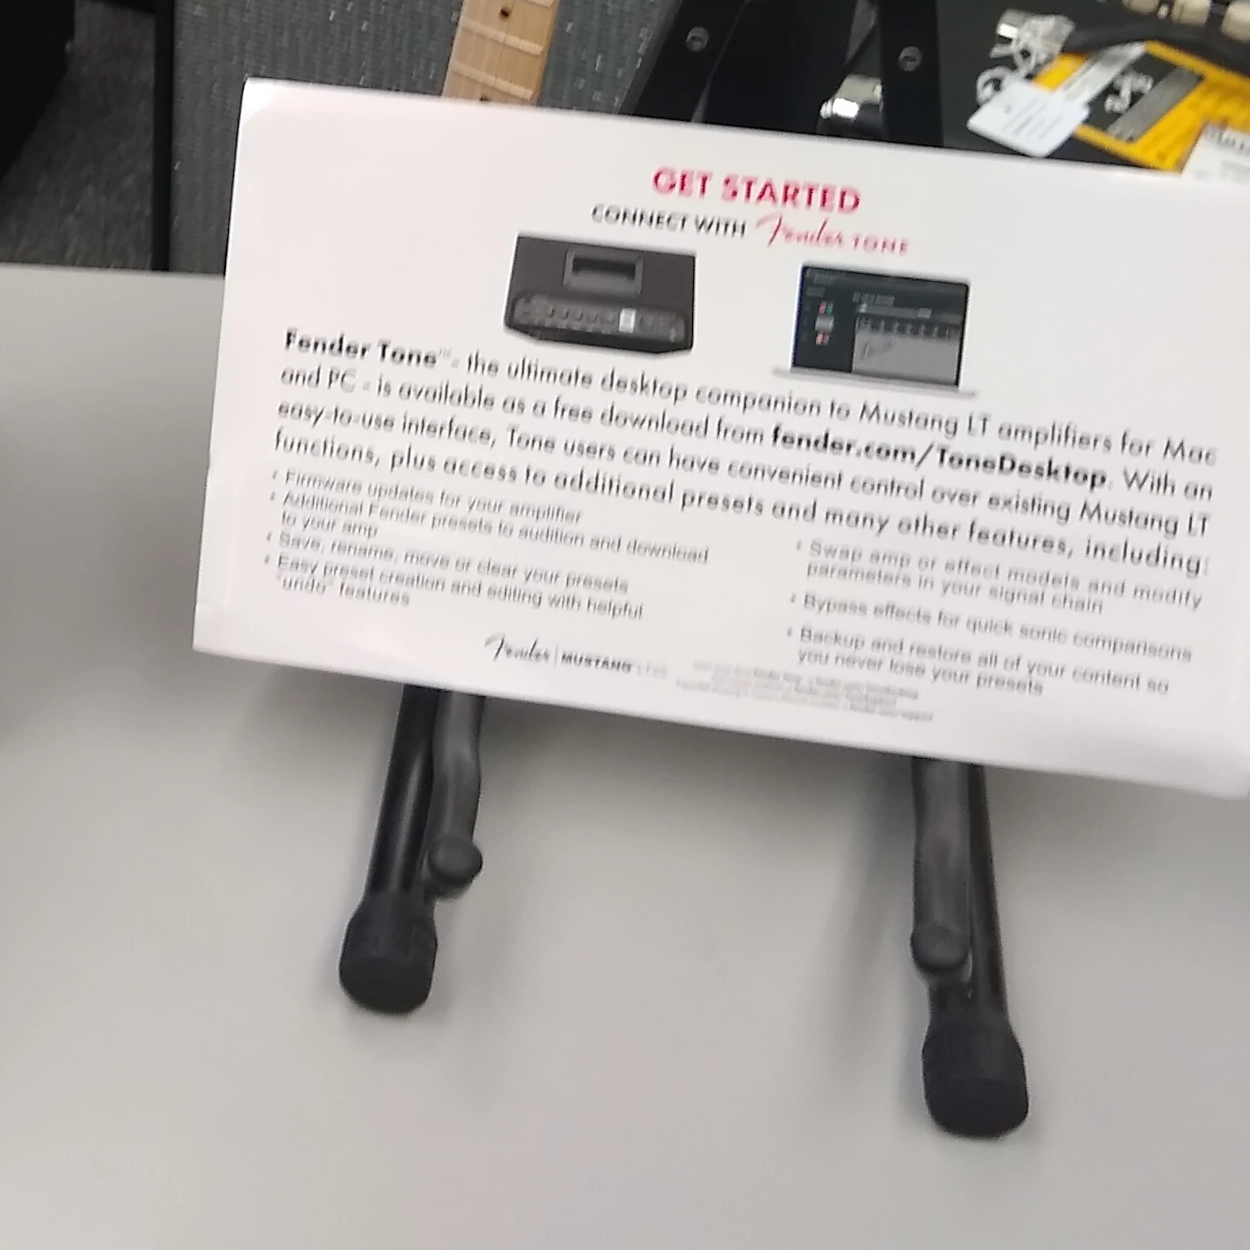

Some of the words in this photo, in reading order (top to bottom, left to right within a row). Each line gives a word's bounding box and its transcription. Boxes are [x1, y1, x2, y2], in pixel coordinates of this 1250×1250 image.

[650, 164, 714, 200] GET
[720, 170, 863, 216] STARTED
[591, 203, 688, 232] CONNECT
[693, 215, 747, 239] WITH
[753, 209, 845, 255] Fender
[851, 233, 910, 257] TONE
[279, 360, 323, 388] and
[326, 367, 358, 393] PC
[375, 374, 395, 399] is
[397, 375, 498, 411] available
[500, 396, 528, 415] as
[530, 400, 549, 418] a
[552, 395, 596, 424] free
[597, 401, 711, 439] download
[710, 415, 767, 446] from
[1118, 466, 1179, 496] With
[1182, 482, 1214, 501] an
[283, 327, 373, 360] Fender
[465, 350, 502, 377] the
[506, 355, 595, 389] ultimate
[598, 366, 690, 406] desktop
[693, 384, 823, 423] companion
[827, 399, 852, 421] to
[857, 400, 961, 440] Mustang
[965, 412, 992, 438] LT
[995, 414, 1115, 459] amplifiers
[1119, 430, 1156, 458] for
[1162, 437, 1217, 465] Mac
[273, 427, 382, 468] functions,
[389, 443, 438, 478] plus
[442, 458, 518, 482] access
[523, 464, 548, 487] to
[553, 464, 676, 504] additional
[680, 487, 765, 521] presets
[770, 495, 818, 523] and
[823, 507, 890, 537] many
[897, 510, 961, 541] other
[967, 520, 1075, 558] features,
[275, 399, 397, 438] easy-to-use
[399, 410, 500, 449] interface,
[503, 426, 559, 453] Tone
[561, 439, 618, 462] users
[621, 447, 662, 467] can
[666, 445, 723, 476] have
[726, 457, 845, 492] convenient
[849, 468, 926, 501] control
[929, 486, 982, 509] over
[985, 490, 1073, 525] existing
[1076, 499, 1185, 541] Mustang
[1185, 512, 1213, 537] LT
[284, 469, 364, 496] Firmware
[366, 479, 436, 509] updates
[439, 489, 464, 509] for
[465, 495, 505, 518] your
[507, 500, 582, 528] amplifier
[277, 529, 328, 554] Save,
[329, 538, 401, 565] rename,
[402, 548, 451, 571] move
[453, 556, 473, 574] or
[475, 558, 520, 579] clear
[521, 566, 562, 589] your
[564, 571, 631, 597] presets
[282, 491, 365, 518] Additional
[366, 501, 429, 525] Fender
[429, 511, 494, 538] presets
[496, 518, 516, 539] to
[517, 522, 587, 548] audition
[588, 532, 623, 553] and
[625, 537, 710, 565] download
[275, 552, 321, 580] Easy
[321, 559, 376, 587] preset
[377, 566, 448, 592] creation
[449, 577, 483, 598] and
[484, 581, 545, 610] editing
[545, 590, 583, 612] with
[585, 595, 645, 623] helpful
[805, 558, 914, 590] parameters
[916, 574, 937, 591] in
[939, 577, 985, 601] your
[987, 582, 1047, 608] signal
[1047, 590, 1106, 615] chain
[808, 540, 865, 568] Swap
[867, 548, 912, 574] amp
[916, 555, 939, 577] or
[942, 555, 1002, 580] effect
[1005, 565, 1082, 597] models
[1085, 575, 1128, 603] and
[1131, 582, 1204, 612] modify
[483, 631, 552, 668] Fender
[560, 651, 633, 674] MUSTANG
[799, 625, 867, 652] Backup
[870, 635, 905, 661] and
[908, 641, 972, 665] restore
[976, 650, 999, 669] all
[1002, 654, 1022, 672] of
[1025, 660, 1066, 684] your
[1071, 666, 1142, 690] content
[1145, 677, 1170, 695] so
[800, 591, 870, 620] Bypass
[871, 600, 934, 624] effects
[935, 610, 963, 629] for
[964, 614, 1015, 639] quick
[1017, 623, 1070, 645] sonic
[1070, 632, 1196, 665] comparisons
